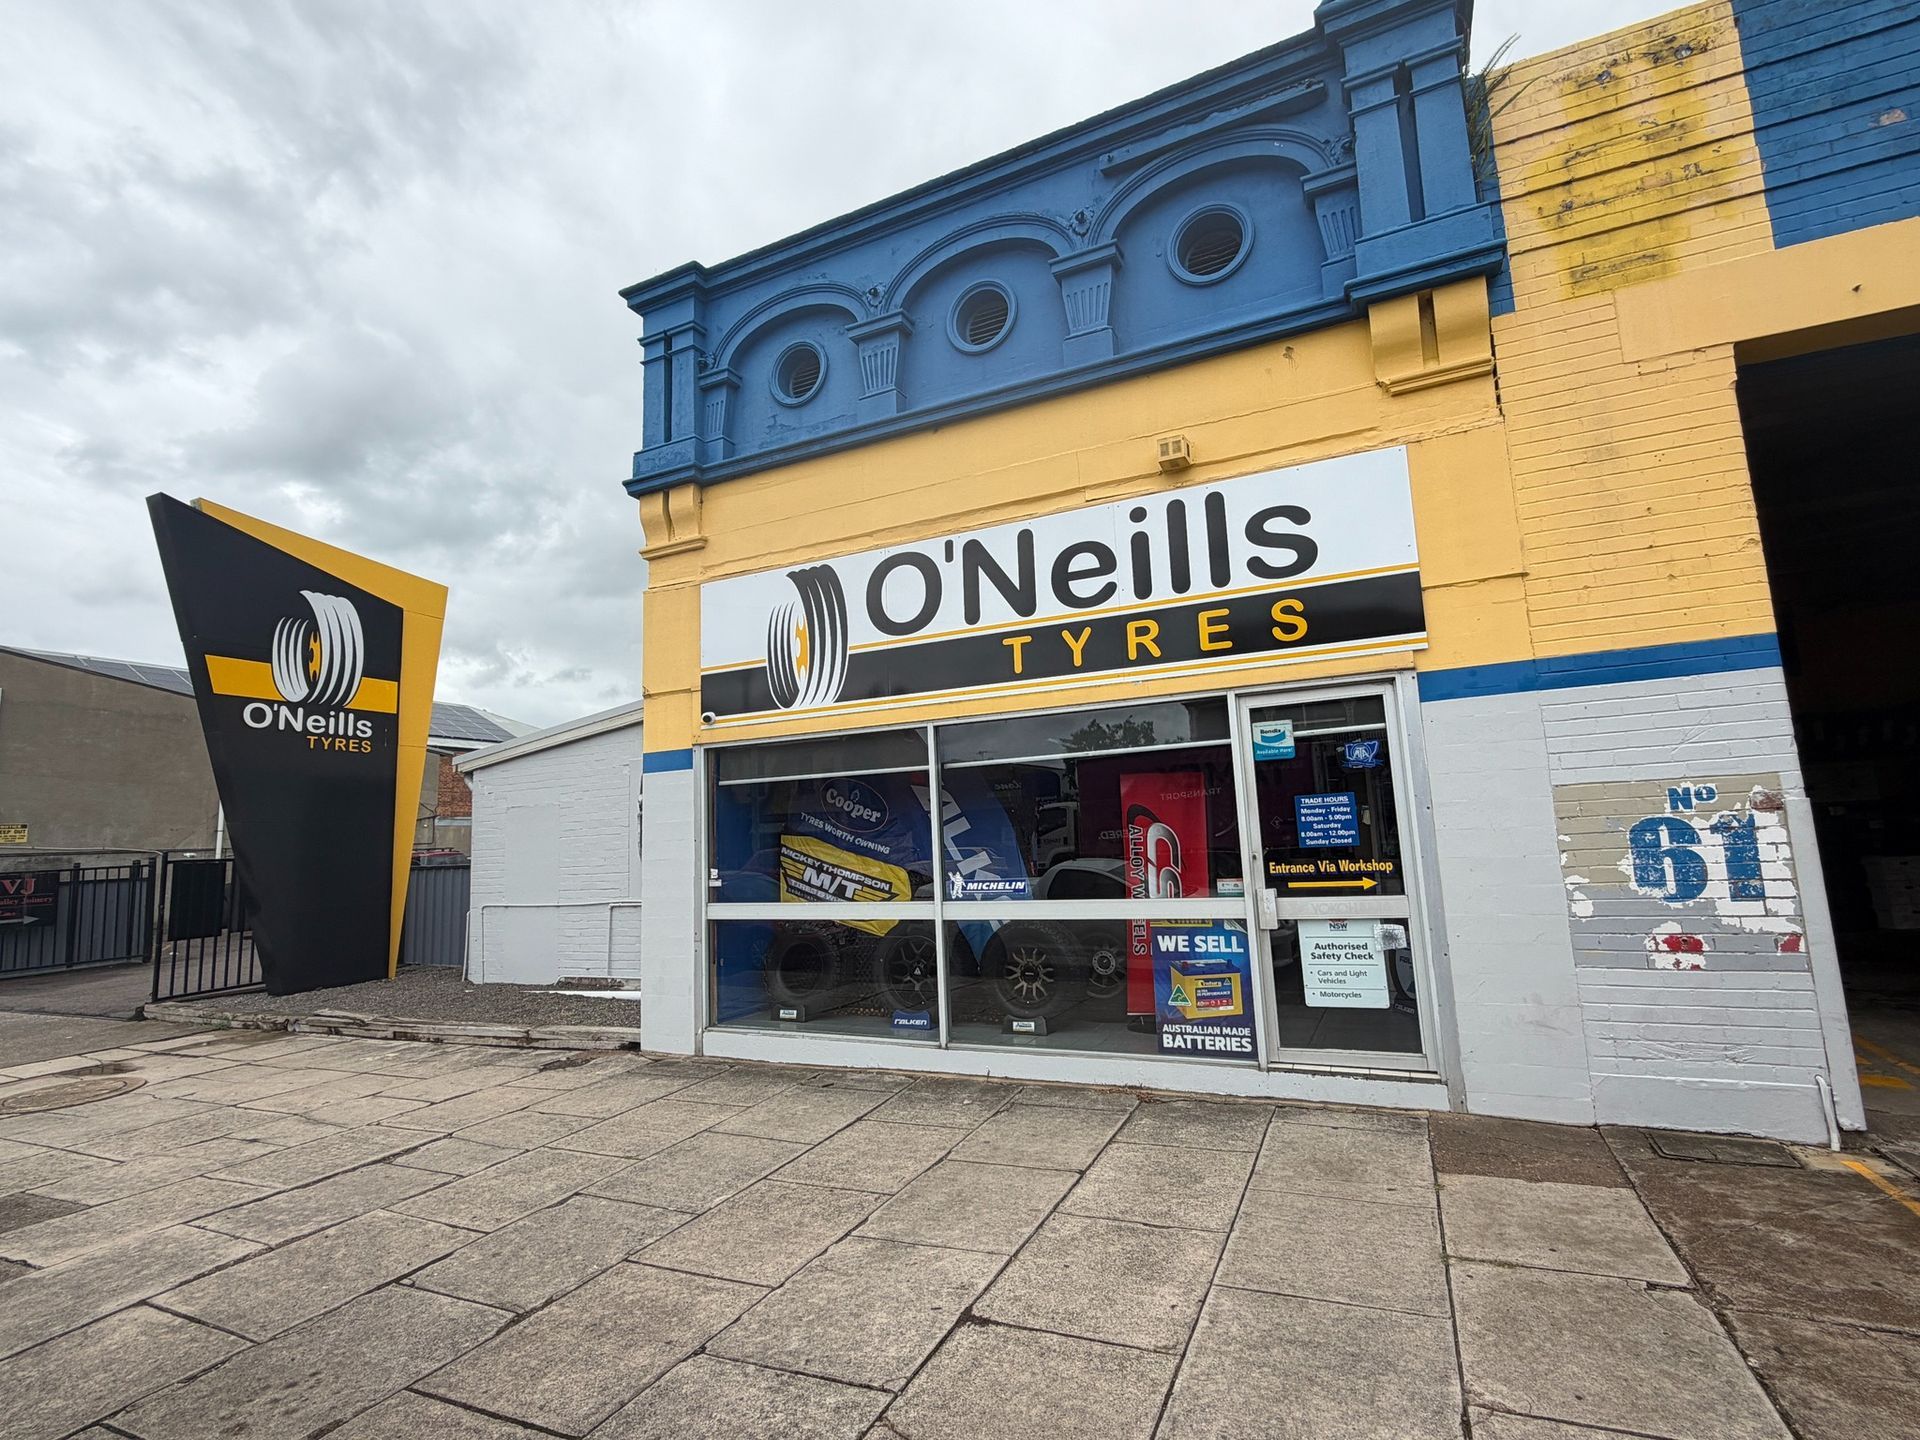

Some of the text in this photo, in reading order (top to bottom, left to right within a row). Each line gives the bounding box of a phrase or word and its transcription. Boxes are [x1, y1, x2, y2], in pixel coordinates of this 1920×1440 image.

[866, 491, 1318, 636] O'Neills
[1003, 599, 1308, 674] TYRES
[243, 702, 373, 738] O'Neills
[306, 735, 372, 753] TYRES
[825, 788, 881, 822] Cooper
[800, 811, 891, 855] TYRES WORTH OWNING
[1305, 838, 1329, 846] Sunday
[1129, 824, 1145, 881] ALLOY
[1629, 814, 1766, 903] 61
[781, 846, 891, 891] MICKEY THOMPSON
[1269, 859, 1393, 874] Entrance Via Workshop
[802, 866, 863, 899] M/T
[966, 881, 1025, 891] MICHELIN
[1329, 922, 1348, 930] NSW
[1157, 935, 1244, 953] WE SELL
[1314, 942, 1368, 951] Authorised
[1310, 952, 1374, 961] Safety Check
[1317, 977, 1347, 985] Vehicles
[1349, 970, 1368, 979] Light
[1319, 990, 1362, 999] Motorcycles
[893, 1018, 927, 1026] FALKEN
[1162, 1024, 1251, 1037] AUSTRALIAN MADE
[1162, 1034, 1252, 1052] BATTERIES
